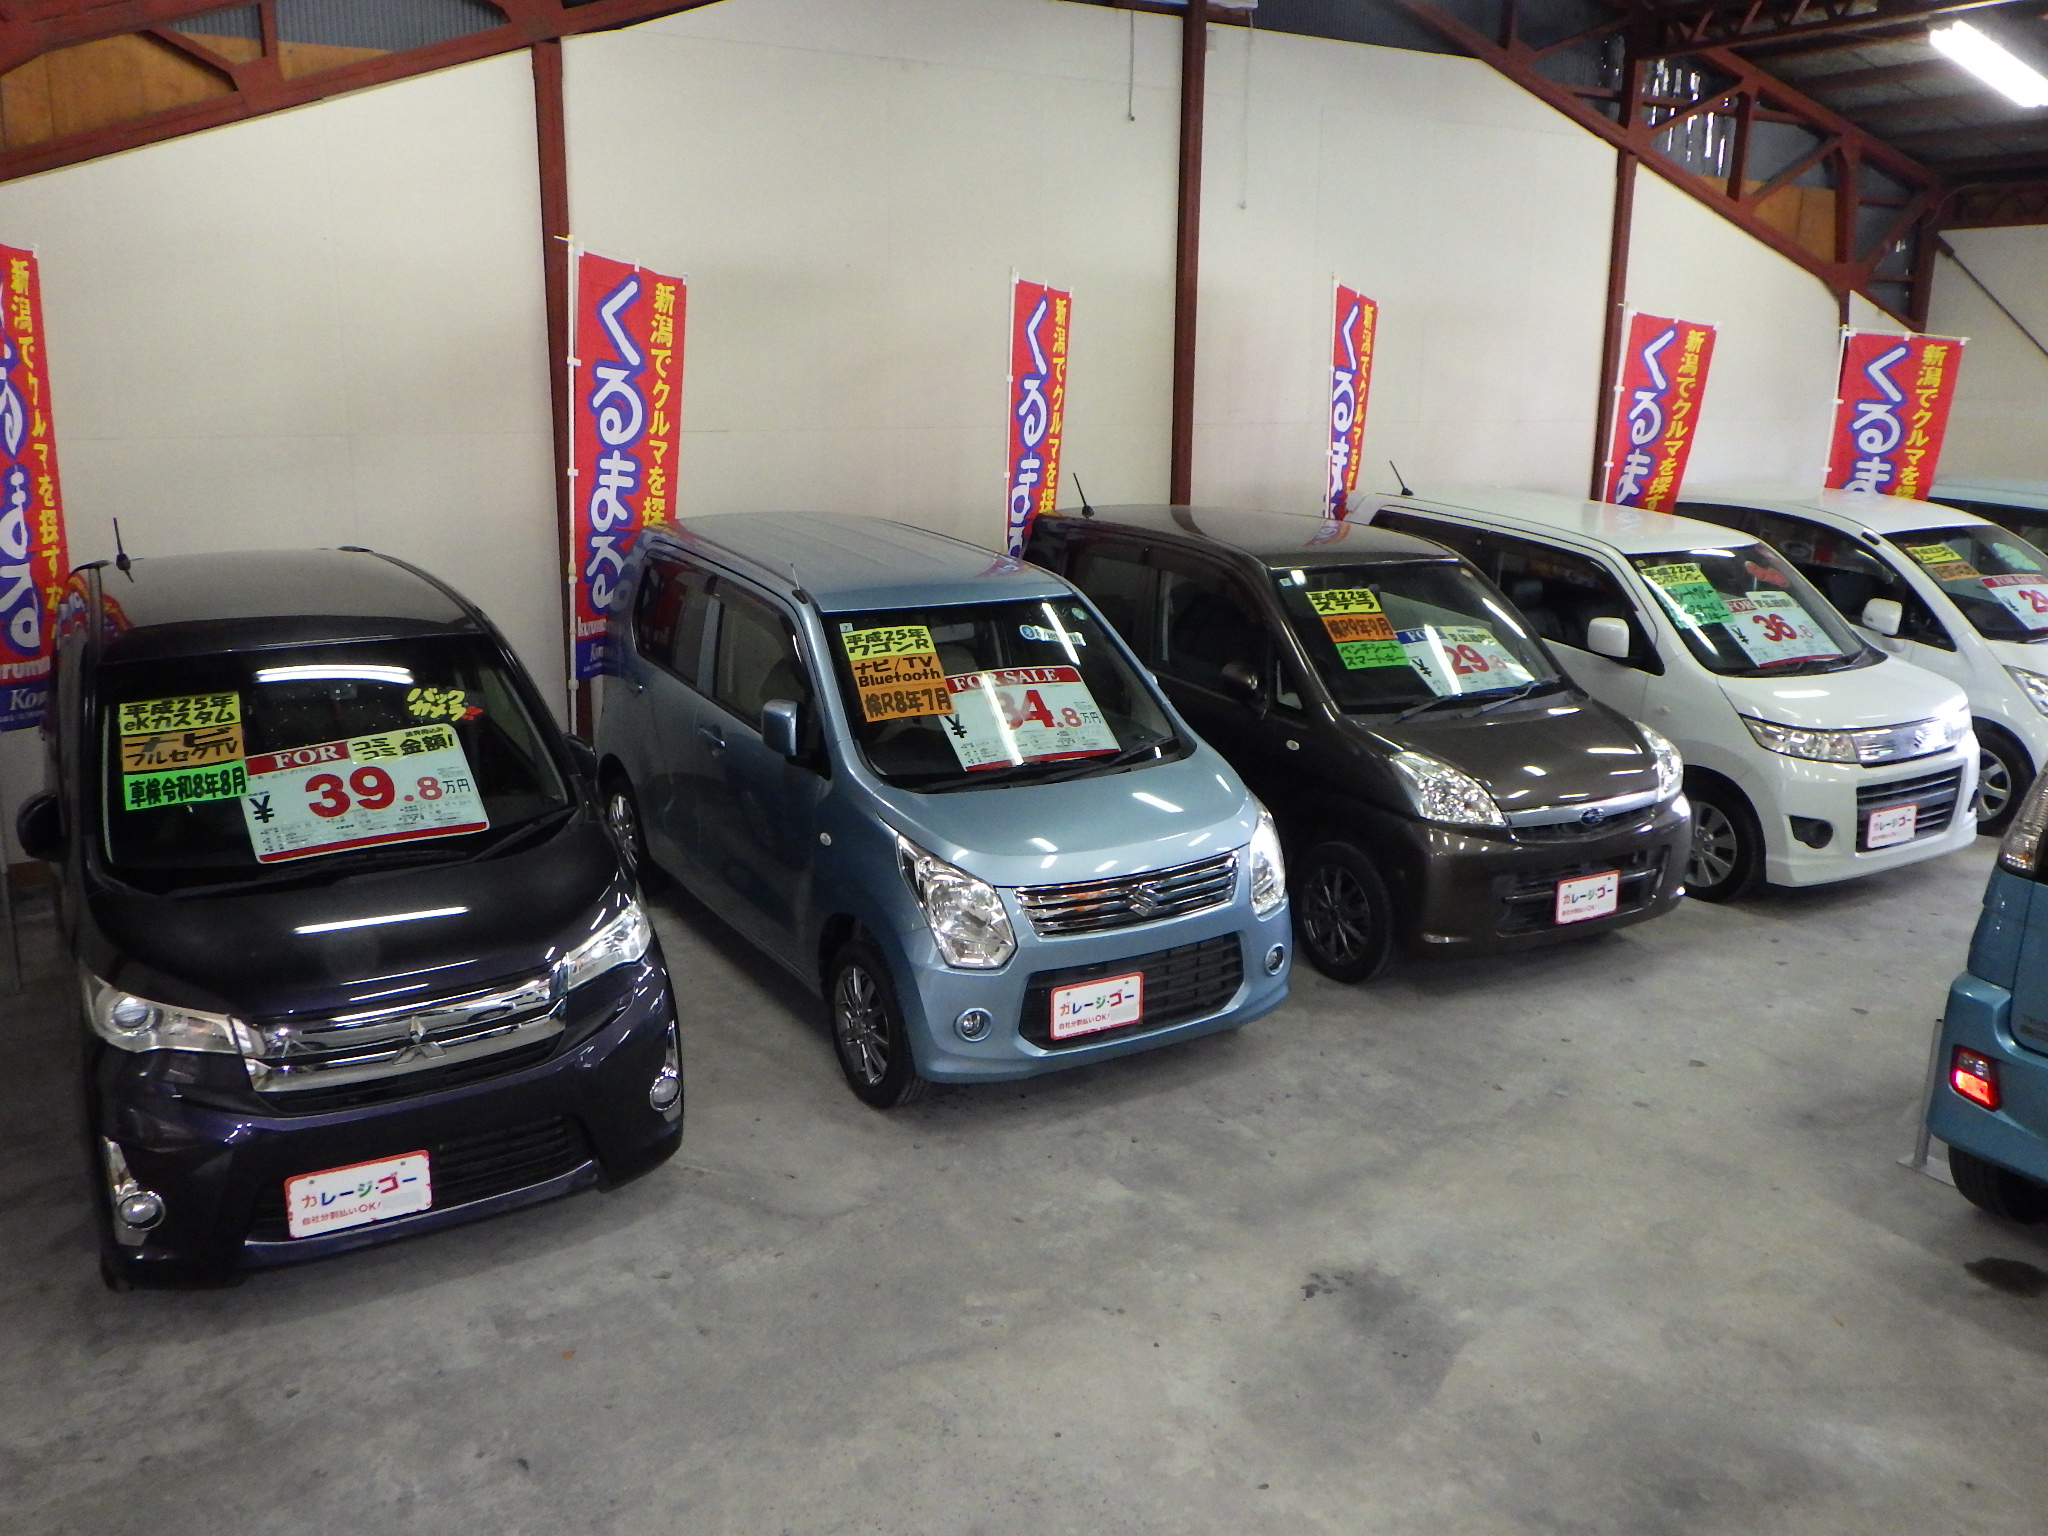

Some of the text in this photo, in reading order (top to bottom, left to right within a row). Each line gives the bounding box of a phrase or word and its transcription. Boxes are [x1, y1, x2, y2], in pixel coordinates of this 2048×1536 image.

[845, 628, 926, 646] 平成25年
[849, 638, 930, 656] ワゴンR
[858, 668, 941, 688] Bluetooth
[1003, 669, 1060, 685] SALE
[124, 695, 234, 717] 平成25年
[407, 688, 465, 705] バック
[865, 687, 952, 719] 検R8年7月
[123, 709, 235, 732] eKカスタム
[275, 745, 341, 769] FOR
[129, 766, 247, 808] 車検令和8年8月
